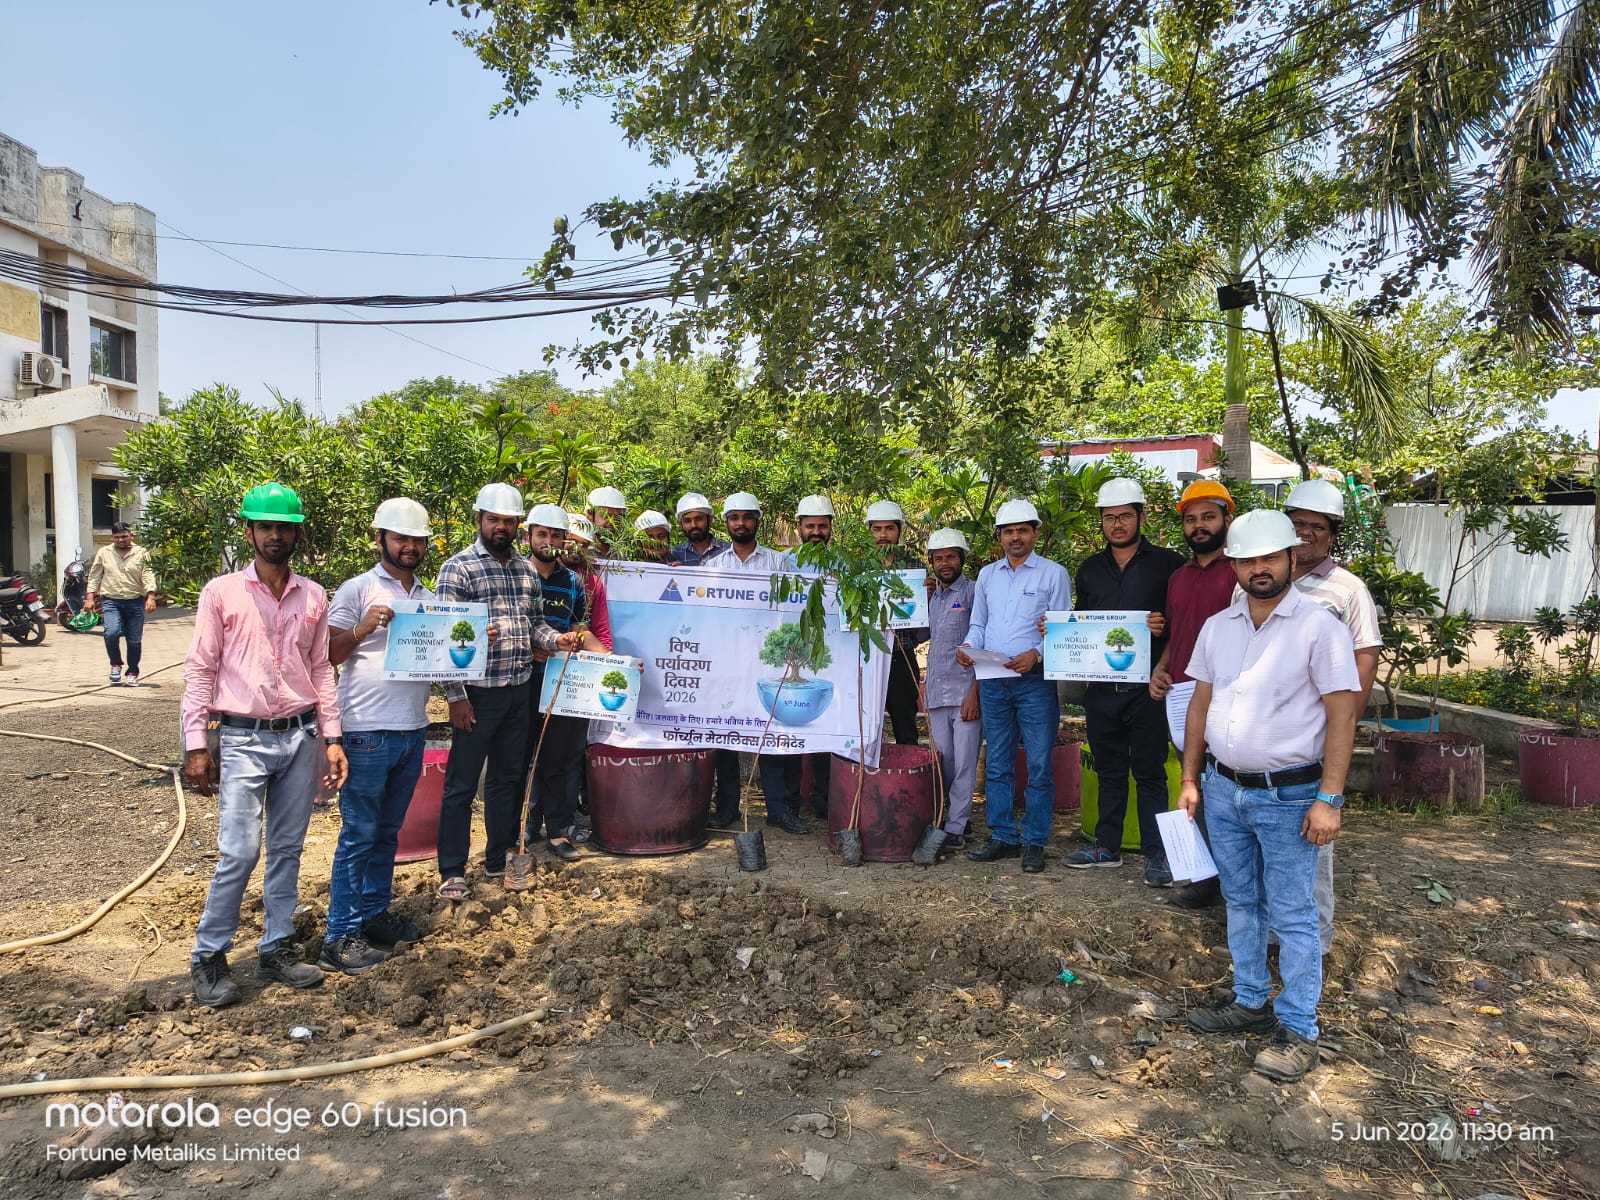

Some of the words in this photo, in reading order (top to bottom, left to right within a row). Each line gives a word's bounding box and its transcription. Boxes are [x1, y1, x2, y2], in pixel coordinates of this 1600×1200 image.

[687, 586, 755, 601] FORTUNE
[759, 591, 808, 604] GUP
[426, 605, 451, 613] FORTUNE
[411, 630, 434, 638] WORLD
[397, 638, 444, 646] ENVIRONMENT
[669, 636, 701, 654] विश्व
[655, 655, 713, 672] पर्यावरण
[664, 672, 701, 689] दिवस
[665, 691, 696, 704] 2026
[680, 713, 687, 722] के
[706, 717, 722, 726] हमारे
[746, 718, 753, 726] के
[705, 731, 760, 747] मेटालिक्स
[762, 734, 806, 749] लिमिटेड
